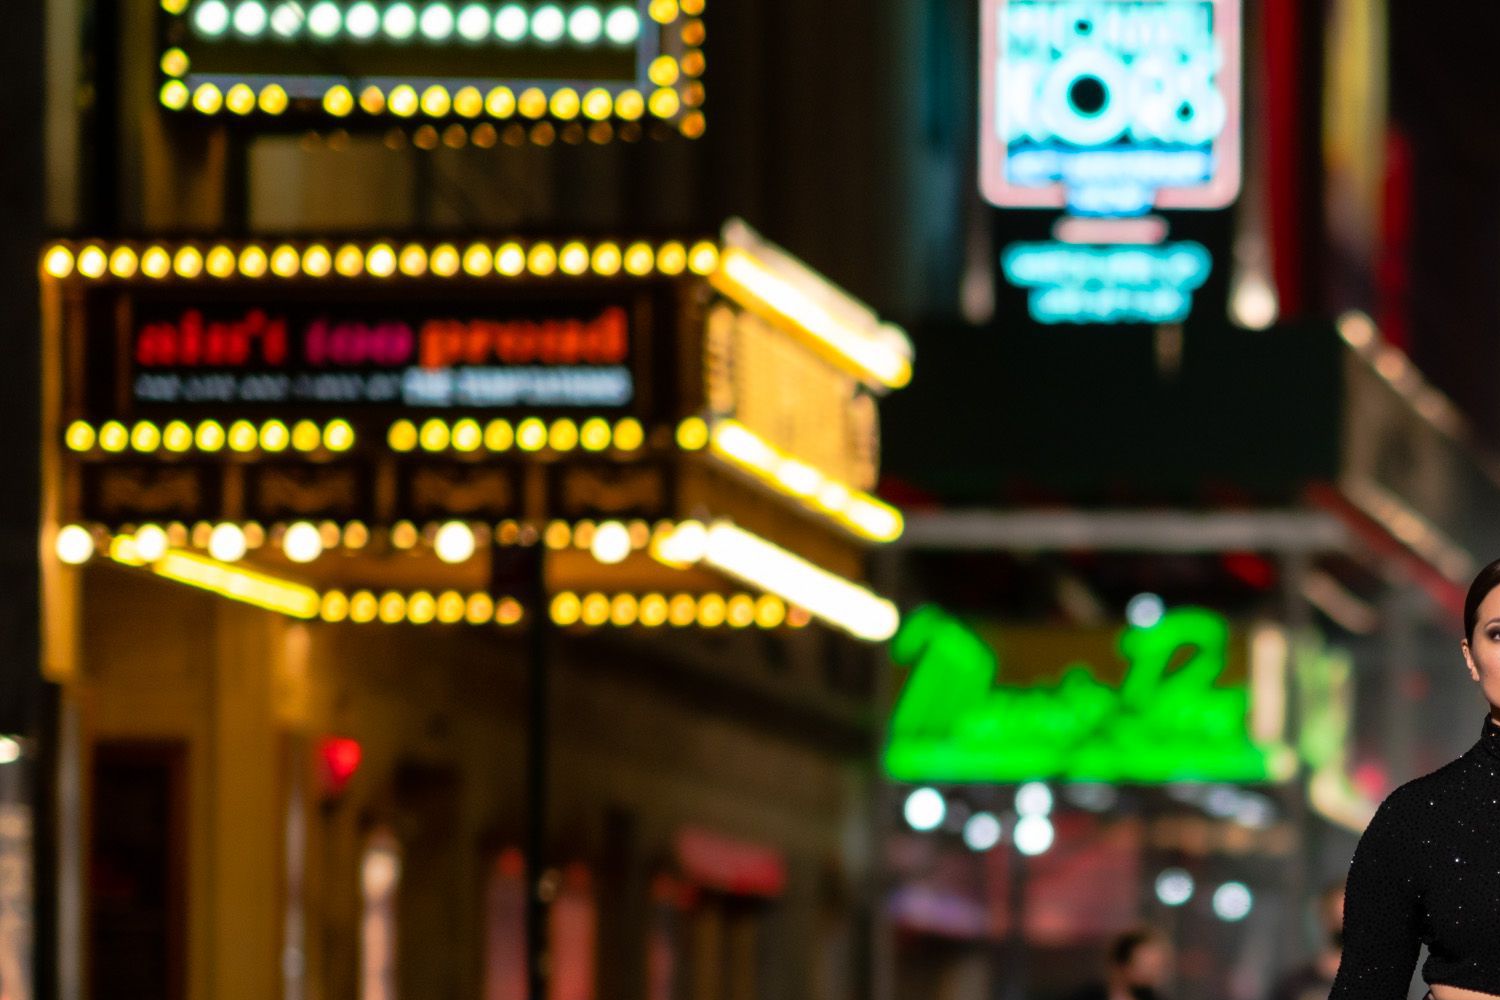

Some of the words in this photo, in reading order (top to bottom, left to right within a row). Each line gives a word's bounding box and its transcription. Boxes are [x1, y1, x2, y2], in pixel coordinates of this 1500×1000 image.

[137, 308, 288, 367] ain't
[305, 318, 415, 366] too
[420, 306, 628, 374] proud
